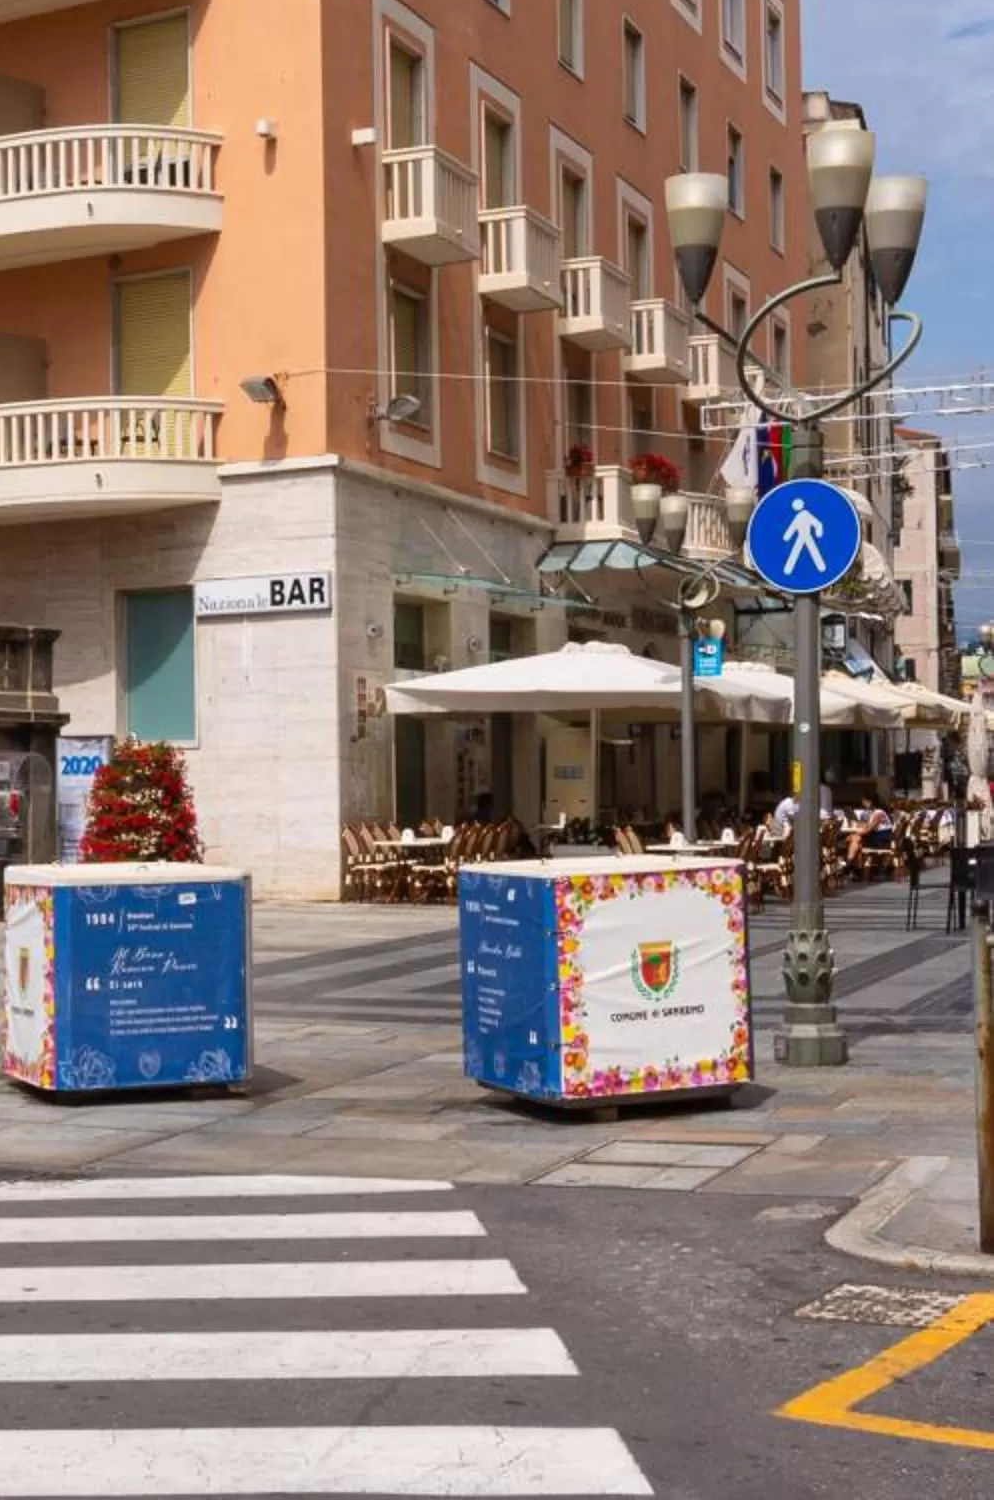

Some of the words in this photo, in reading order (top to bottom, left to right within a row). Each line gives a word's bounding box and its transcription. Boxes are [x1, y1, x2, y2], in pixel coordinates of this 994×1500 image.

[198, 592, 268, 612] Nazionale
[269, 576, 325, 607] BAR
[61, 756, 102, 775] 2020
[610, 1011, 648, 1023] COMUNE
